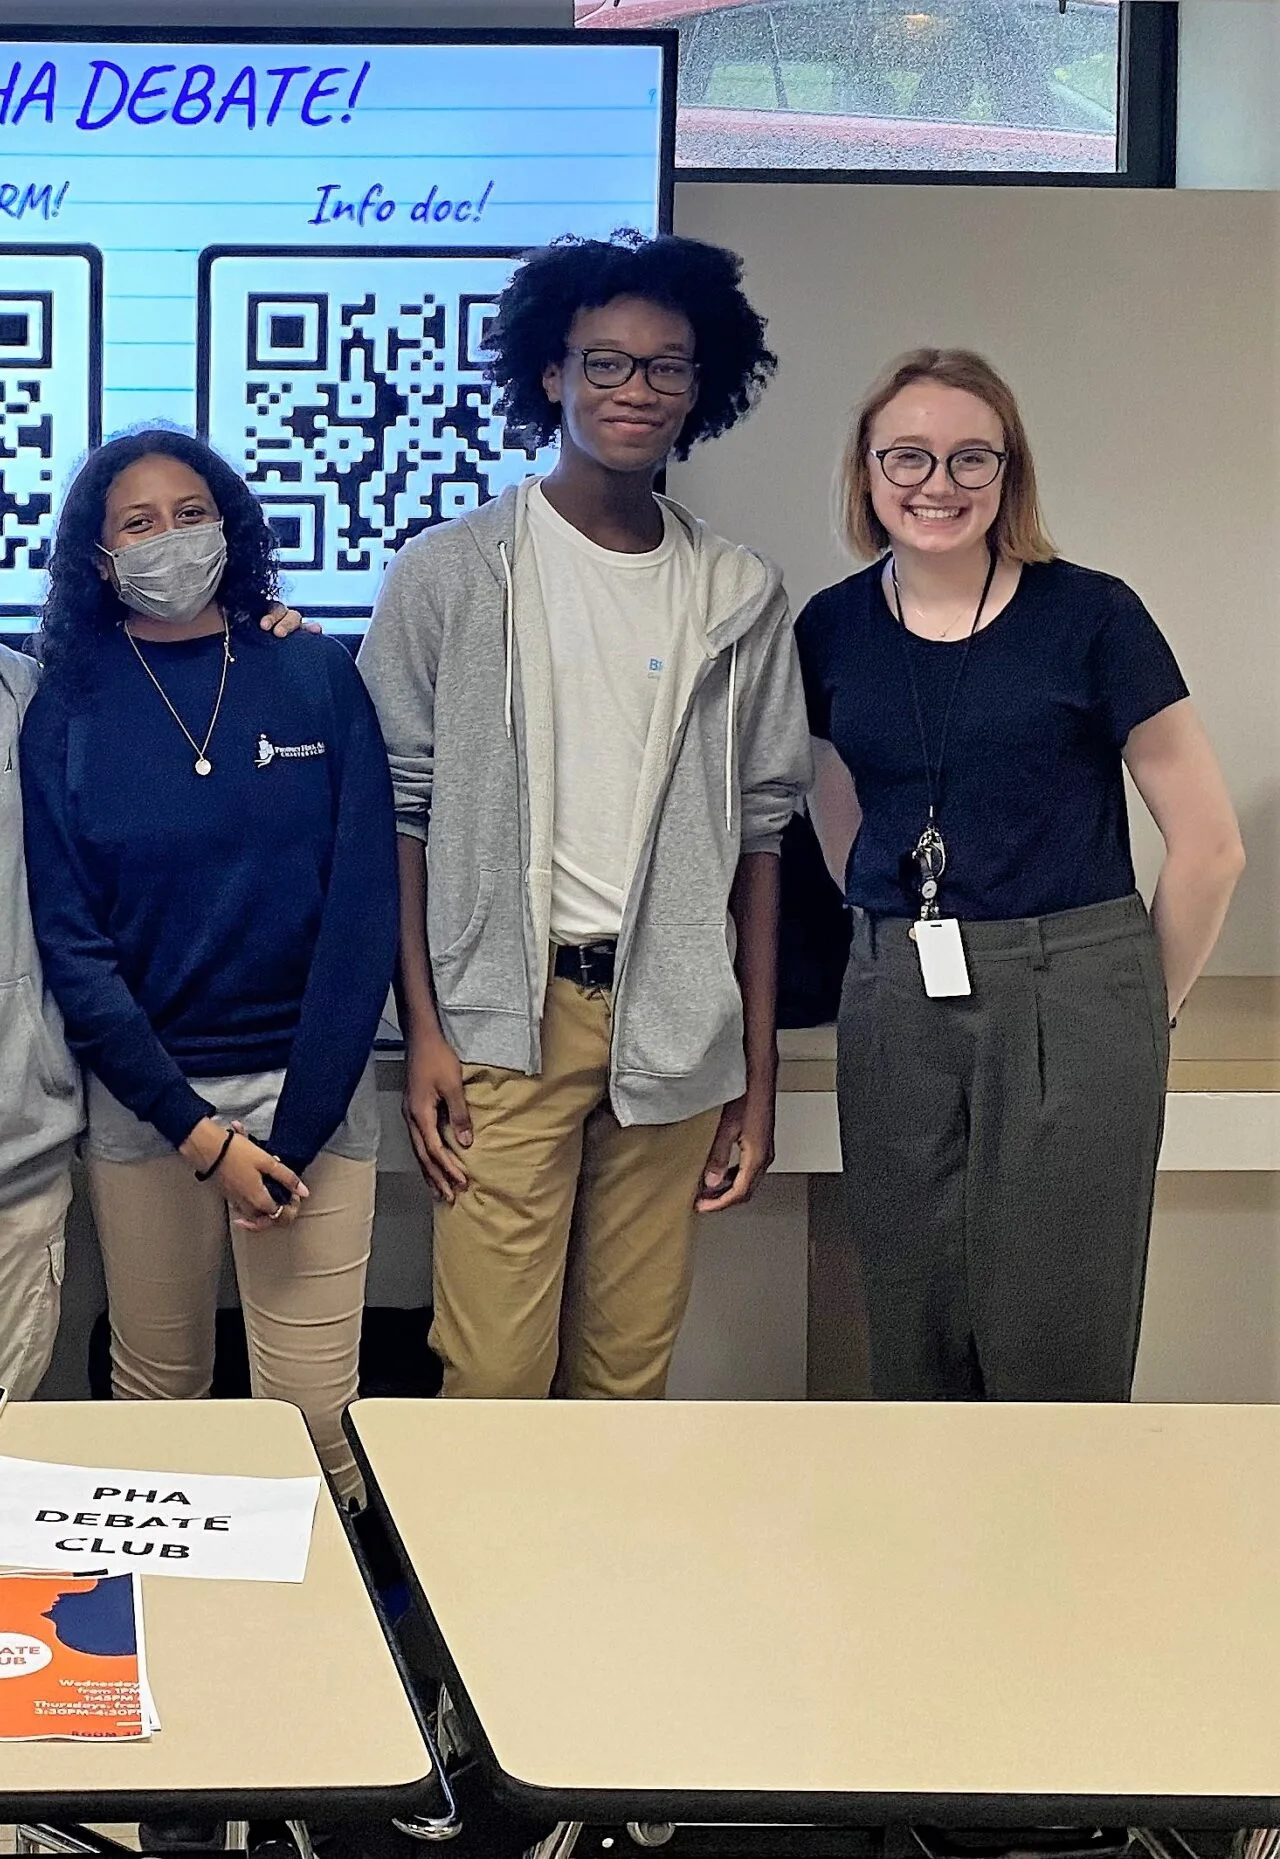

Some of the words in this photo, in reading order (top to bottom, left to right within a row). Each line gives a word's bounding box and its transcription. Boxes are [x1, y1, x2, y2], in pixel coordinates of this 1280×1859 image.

[75, 61, 371, 130] DEBATE!
[308, 182, 396, 228] Info
[410, 179, 494, 223] doc!
[92, 1487, 192, 1505] PHA
[35, 1510, 232, 1532] DEBATE
[55, 1537, 190, 1560] CLUB
[76, 1687, 112, 1695] from
